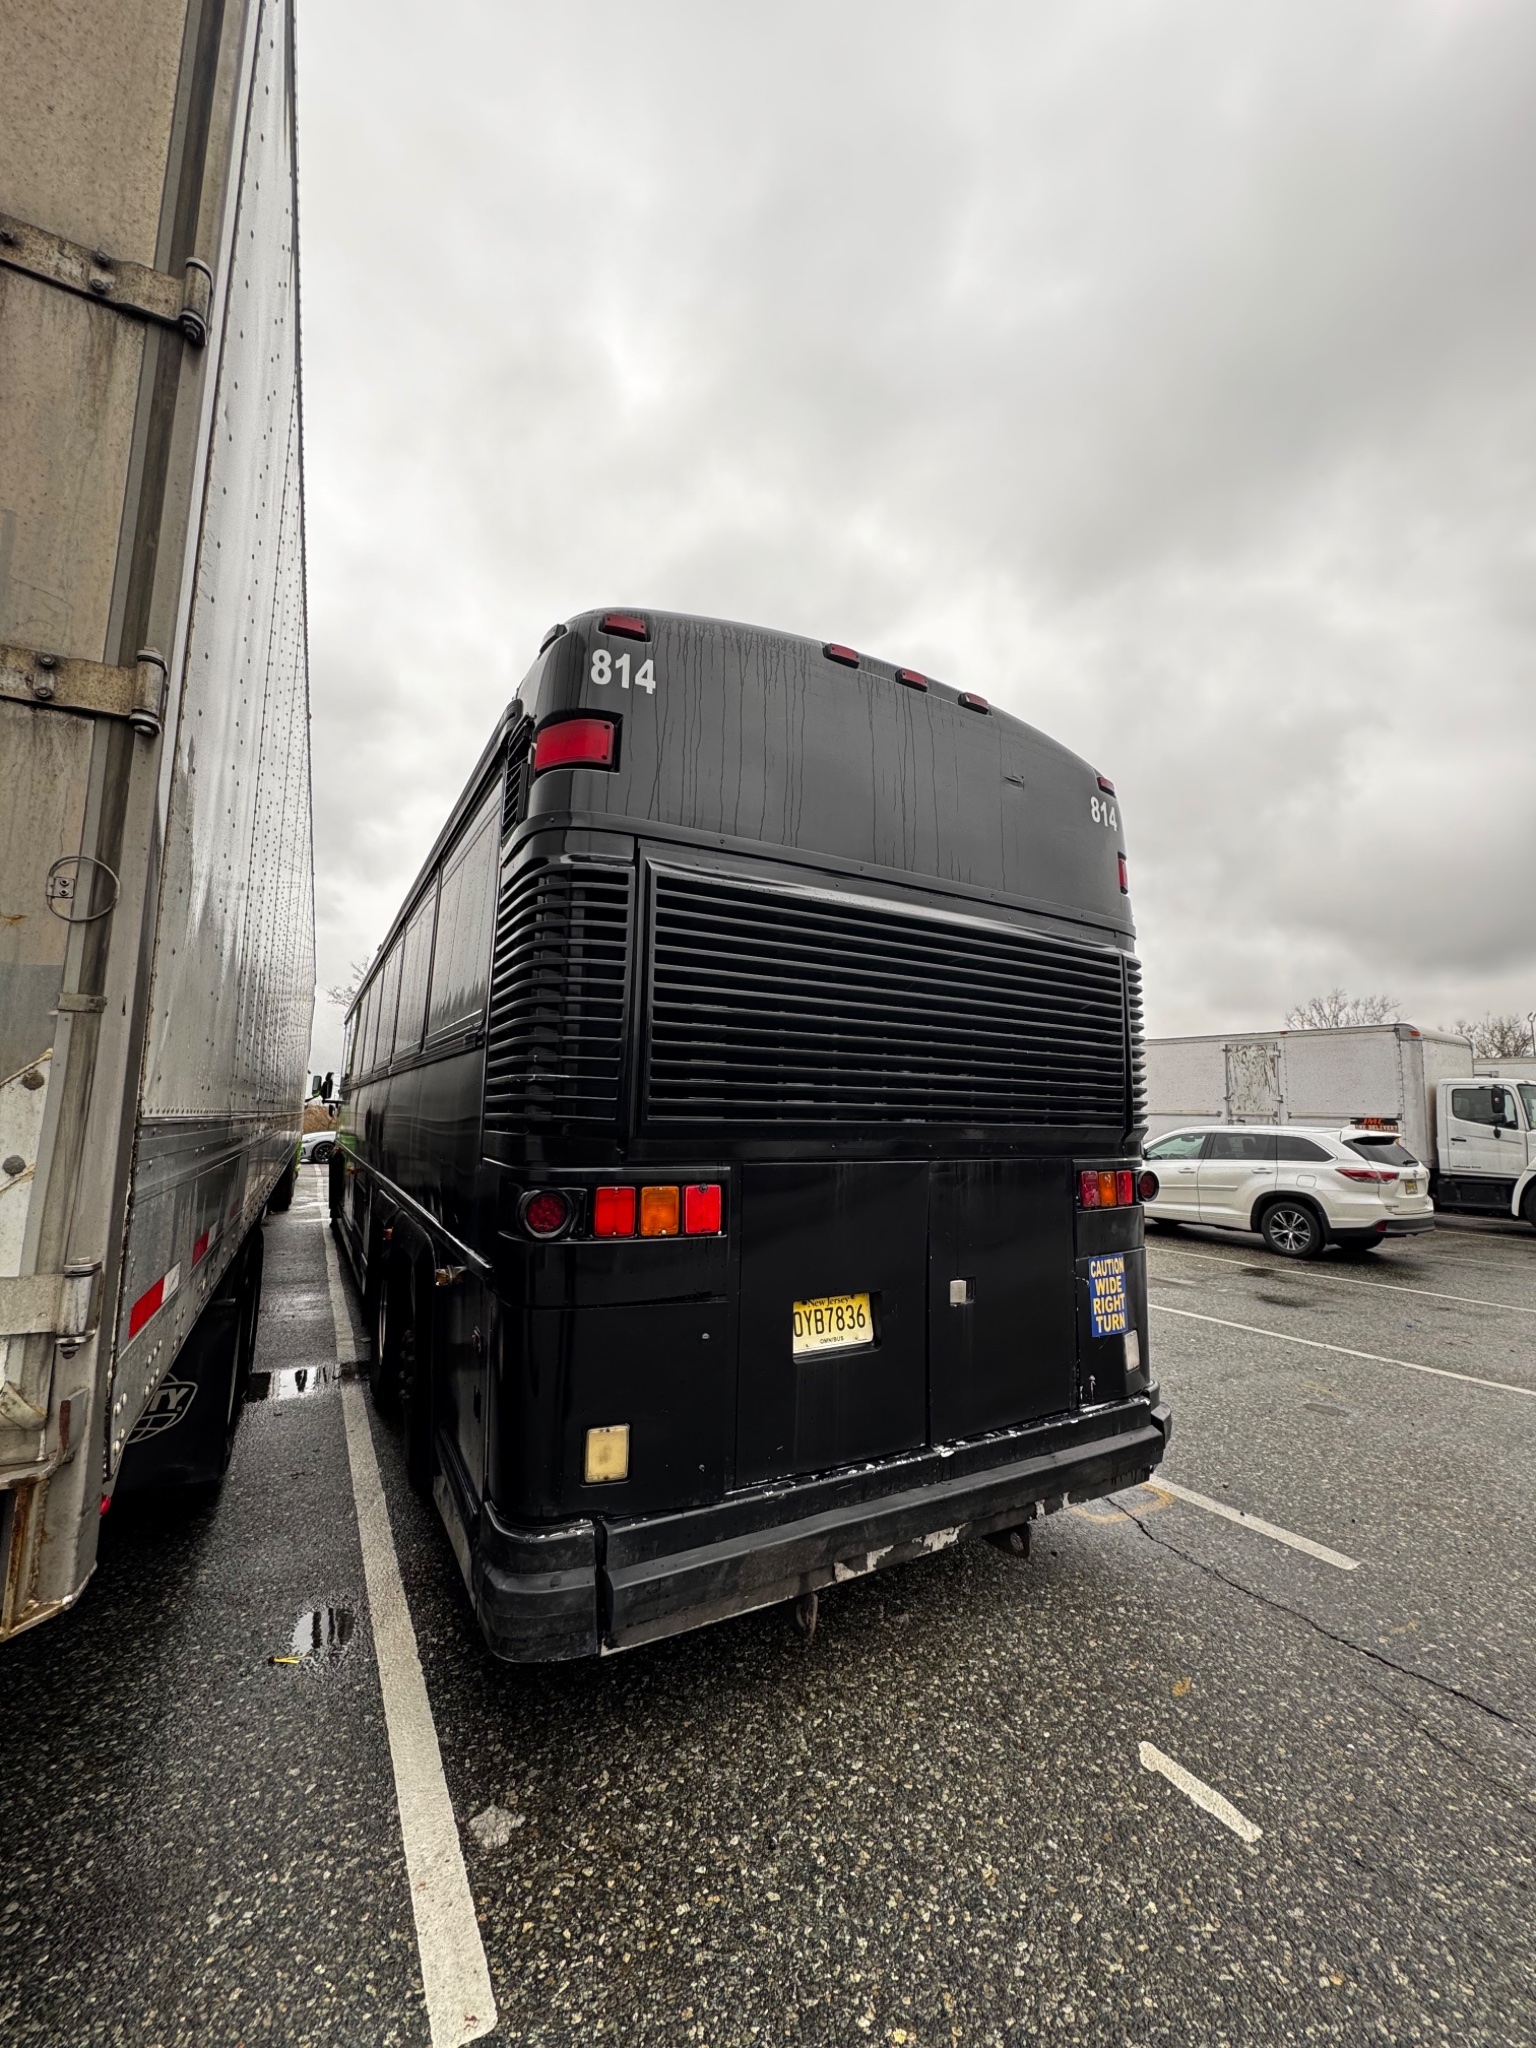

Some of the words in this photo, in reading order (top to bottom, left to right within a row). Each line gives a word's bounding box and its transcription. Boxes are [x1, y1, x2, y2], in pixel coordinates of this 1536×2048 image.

[591, 649, 656, 694] 814
[1091, 796, 1117, 831] 814
[1091, 1257, 1124, 1278] CAUTION
[1095, 1276, 1122, 1296] WIDE
[808, 1299, 826, 1307] New
[827, 1296, 850, 1306] Jersey
[1093, 1293, 1125, 1315] RIGHT
[1096, 1312, 1126, 1333] TURN
[820, 1336, 844, 1344] OMNIBUS
